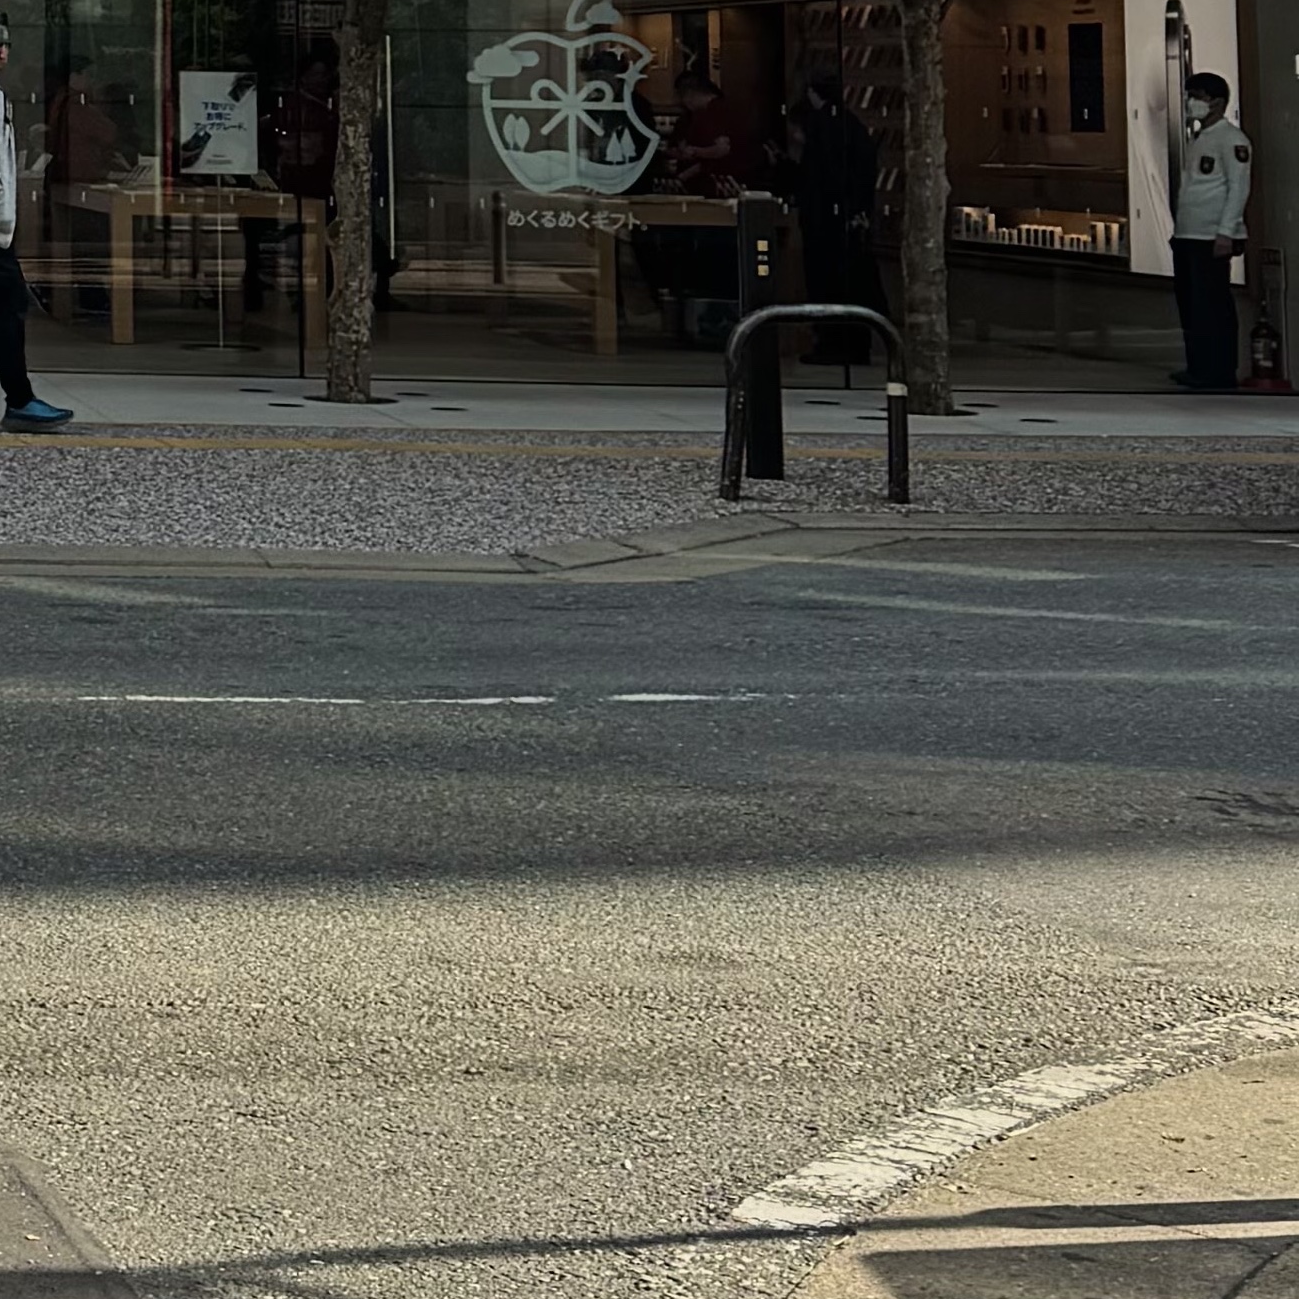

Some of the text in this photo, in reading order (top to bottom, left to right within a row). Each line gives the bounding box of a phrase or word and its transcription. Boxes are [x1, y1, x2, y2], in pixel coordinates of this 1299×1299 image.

[506, 209, 649, 232] めくるめくギフト。
